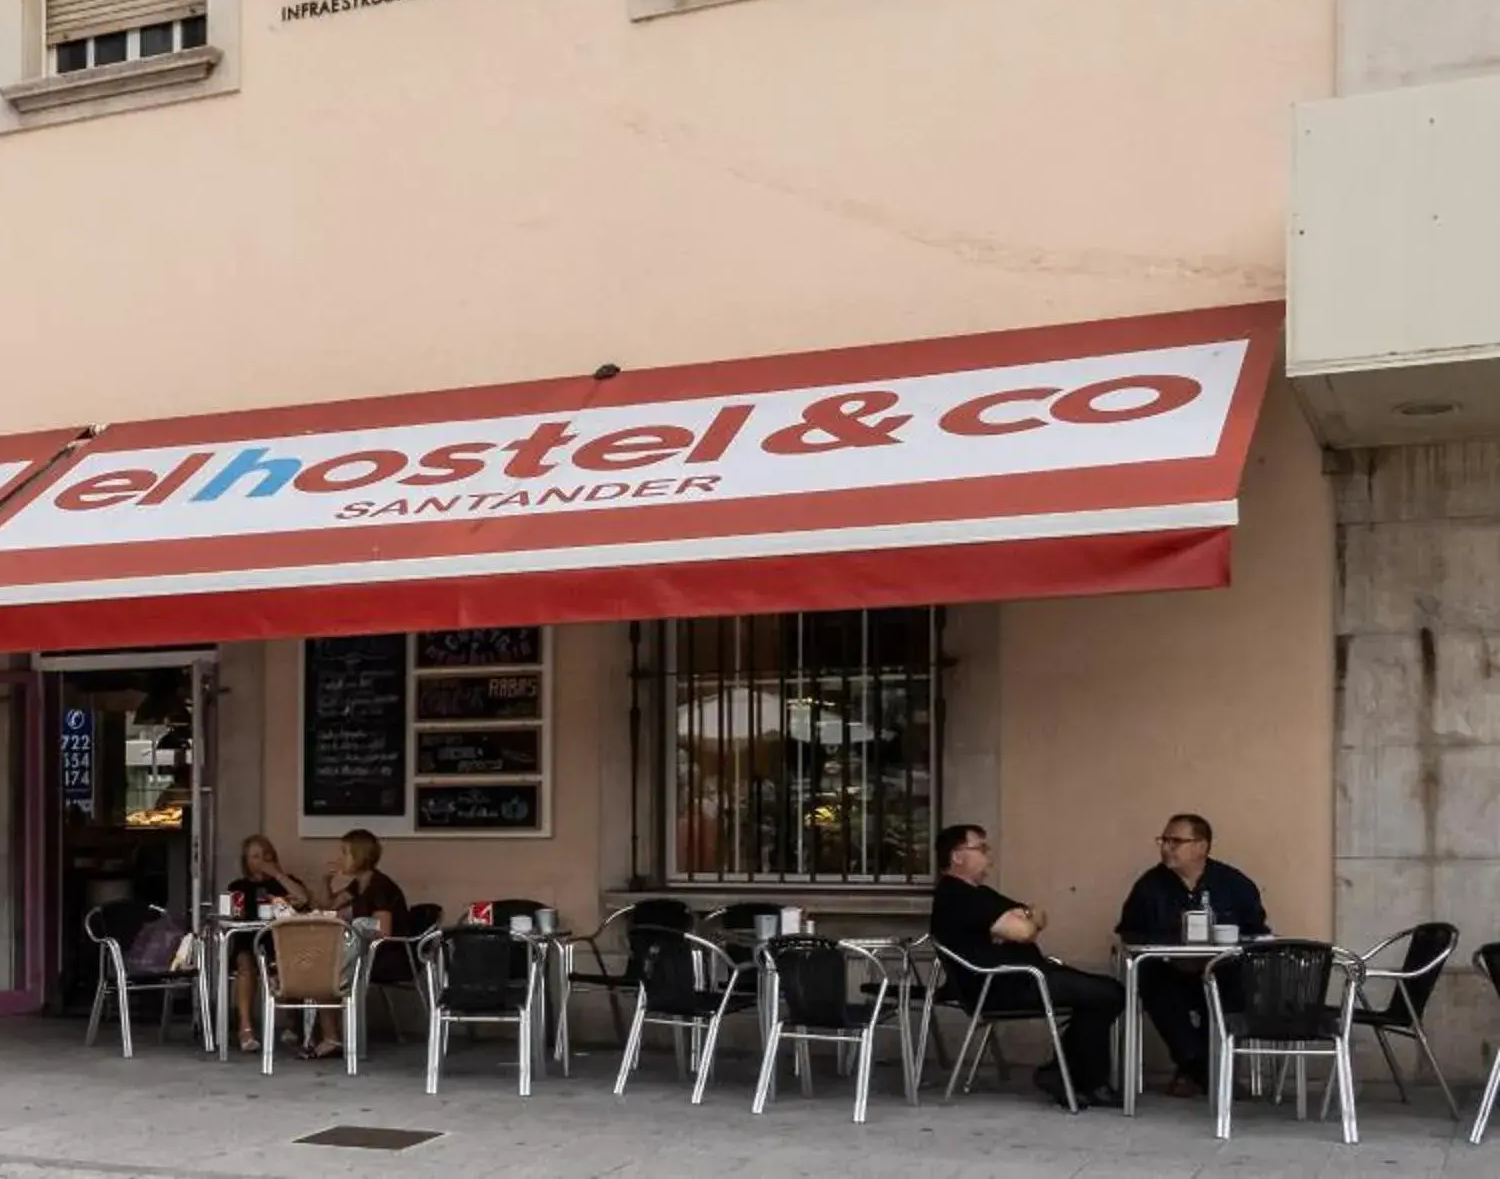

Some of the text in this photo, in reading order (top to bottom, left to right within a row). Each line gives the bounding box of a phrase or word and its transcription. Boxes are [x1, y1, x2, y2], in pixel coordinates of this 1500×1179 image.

[761, 390, 913, 455] &
[335, 474, 722, 520] SANTANDER
[61, 734, 90, 750] 722
